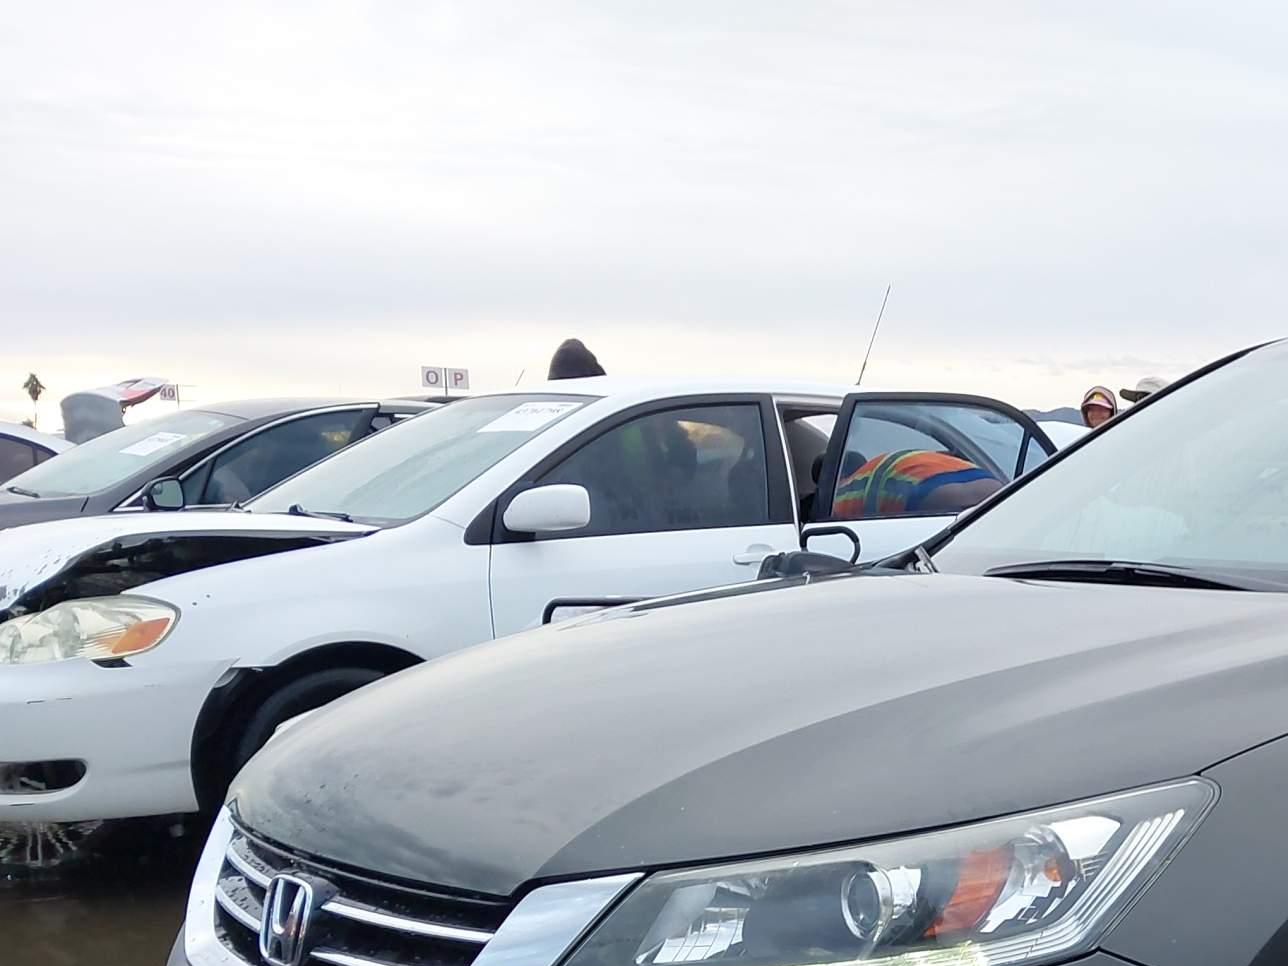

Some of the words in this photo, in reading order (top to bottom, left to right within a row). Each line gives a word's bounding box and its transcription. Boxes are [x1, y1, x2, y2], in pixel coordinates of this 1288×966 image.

[426, 370, 439, 384] O
[453, 372, 464, 386] P
[160, 387, 175, 398] 40
